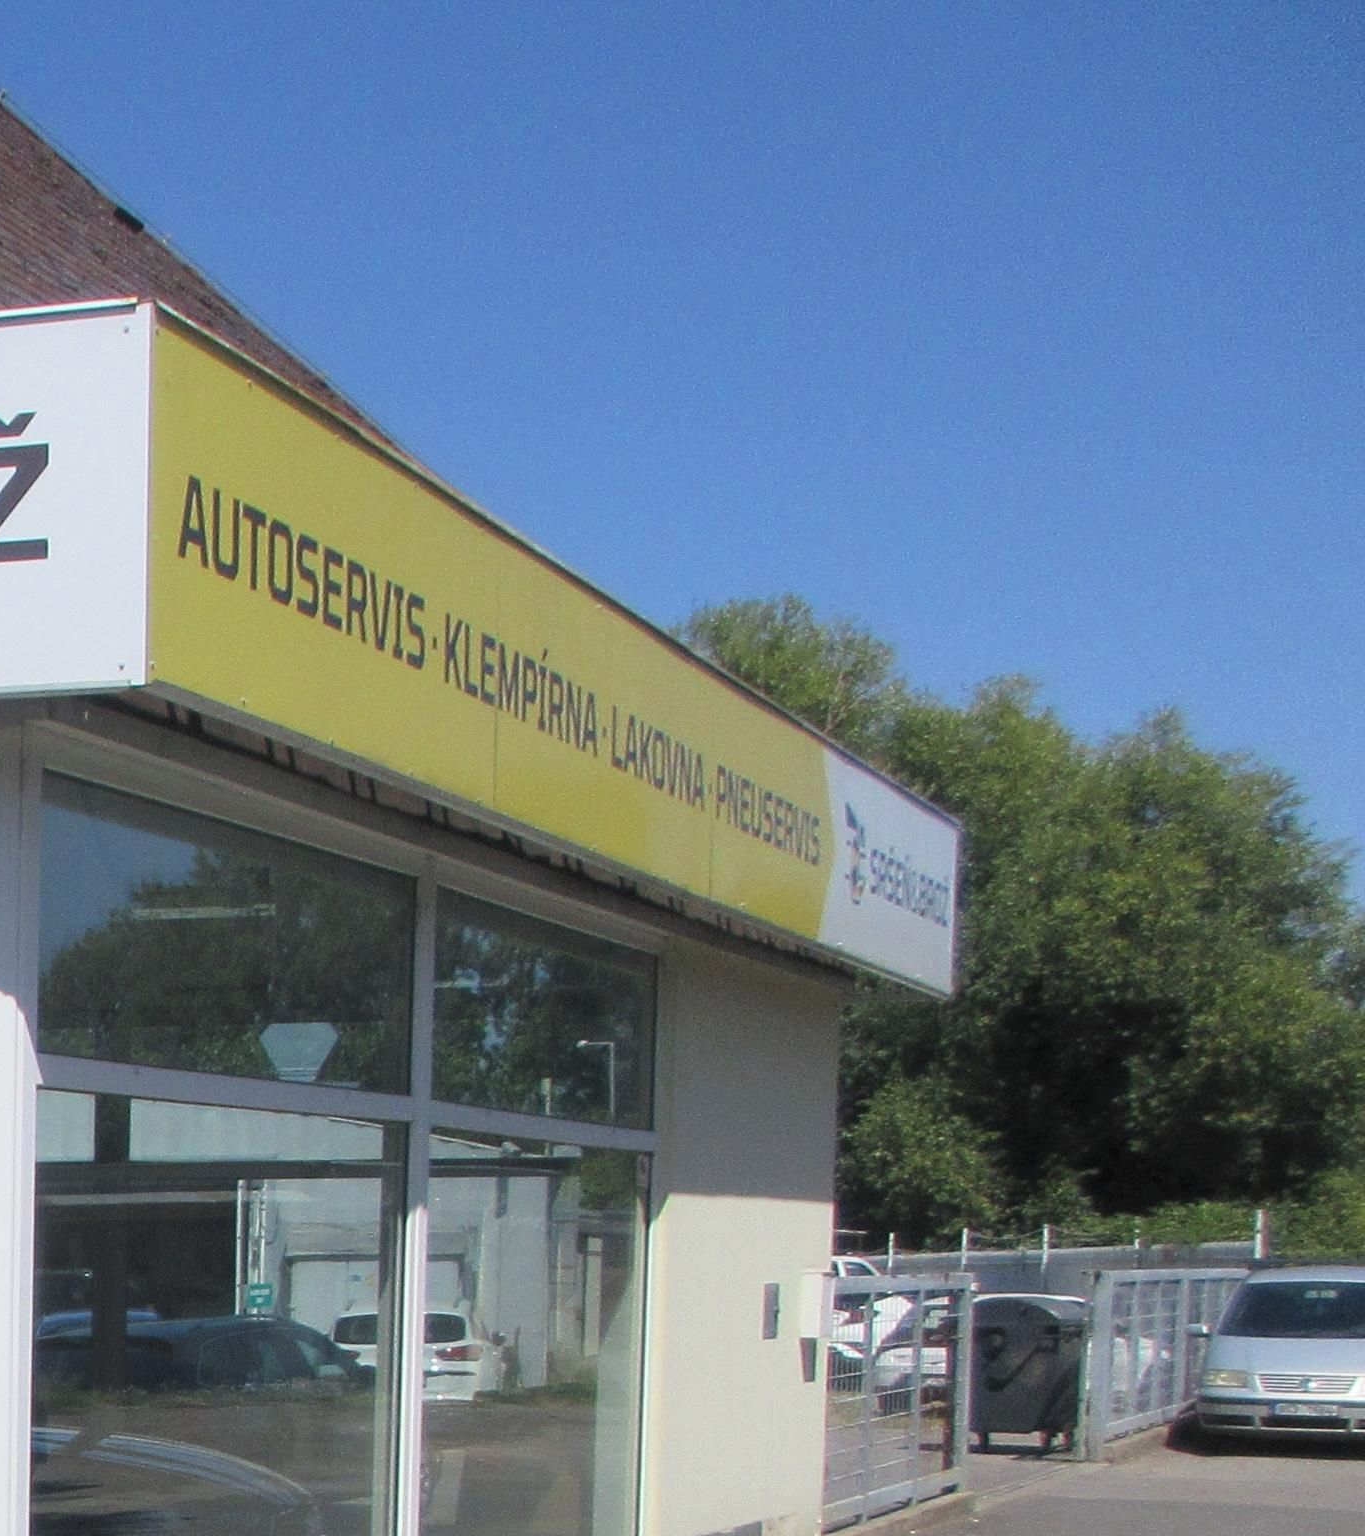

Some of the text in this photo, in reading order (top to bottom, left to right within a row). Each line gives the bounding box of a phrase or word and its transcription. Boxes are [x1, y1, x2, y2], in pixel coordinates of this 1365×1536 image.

[178, 474, 823, 867] AUTOSERVIS KLEMPÍRNA LAKOVNA PNEUSERVIS
